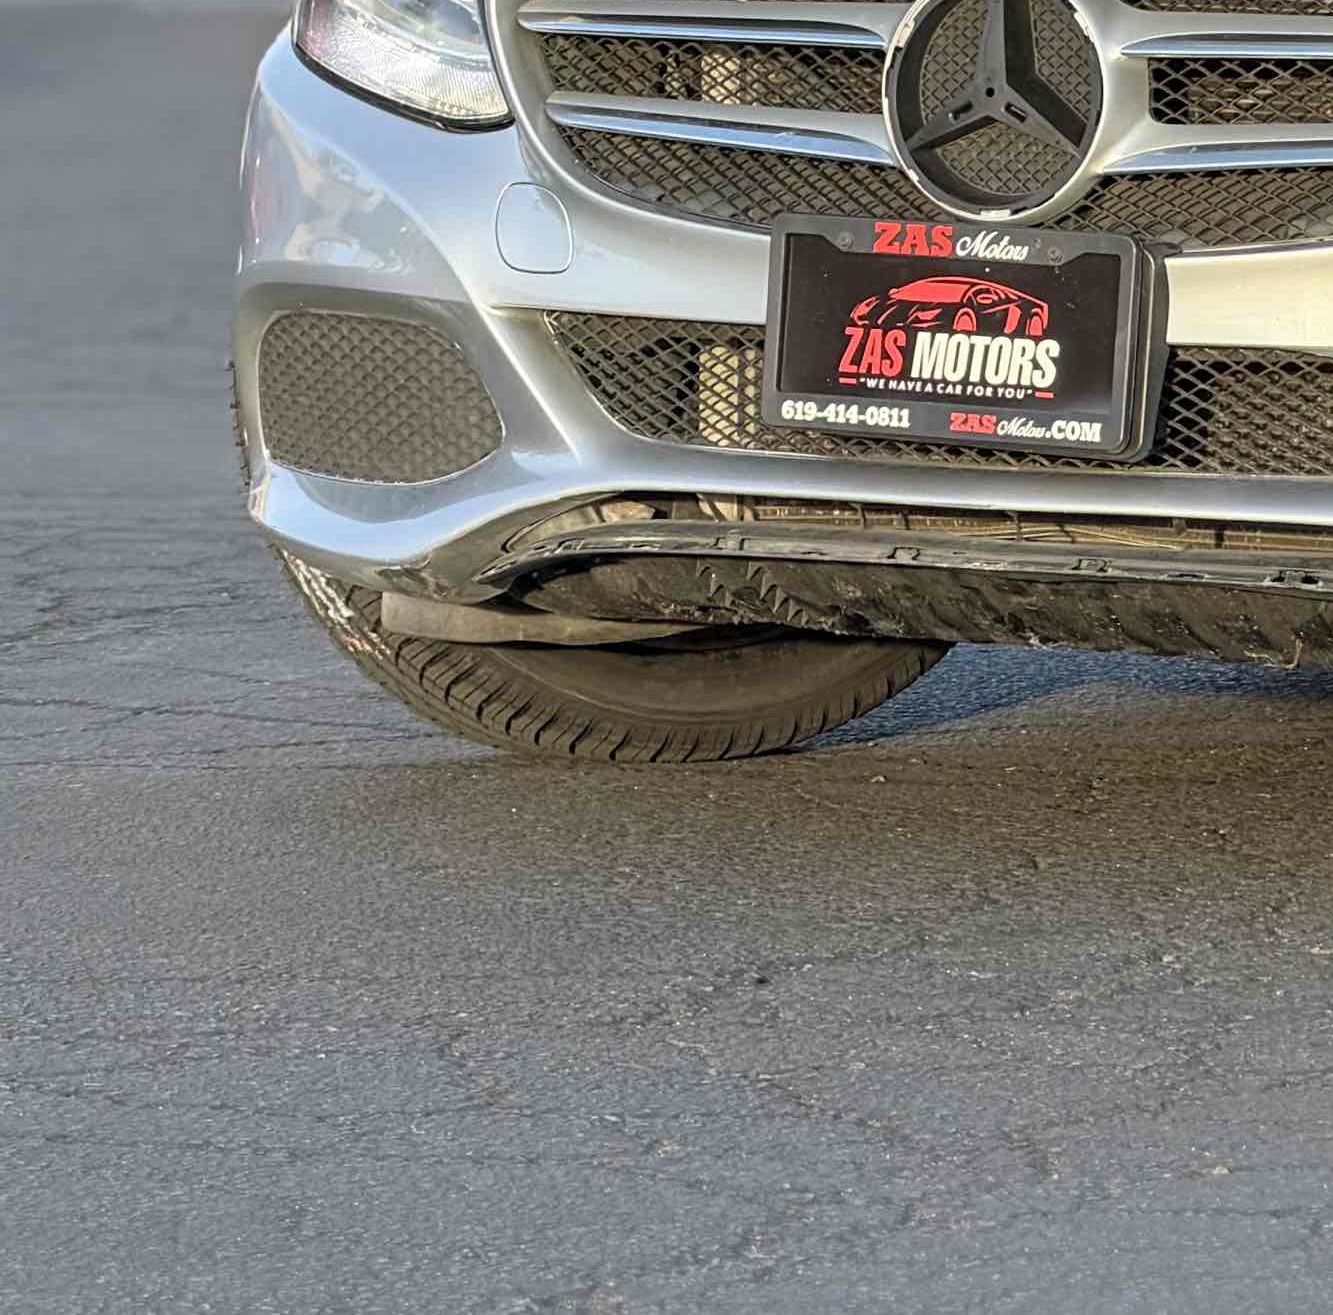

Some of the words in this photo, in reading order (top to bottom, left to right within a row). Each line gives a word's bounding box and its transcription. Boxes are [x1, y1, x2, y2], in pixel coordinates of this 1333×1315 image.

[873, 222, 953, 257] ZAS
[956, 230, 1029, 261] Motors
[838, 326, 906, 377] ZAS
[911, 331, 1060, 388] MOTORS
[888, 380, 922, 392] HAVE
[924, 383, 933, 393] A
[936, 383, 962, 395] CAR
[967, 386, 993, 397] FOR
[781, 400, 910, 428] 619-414-0811
